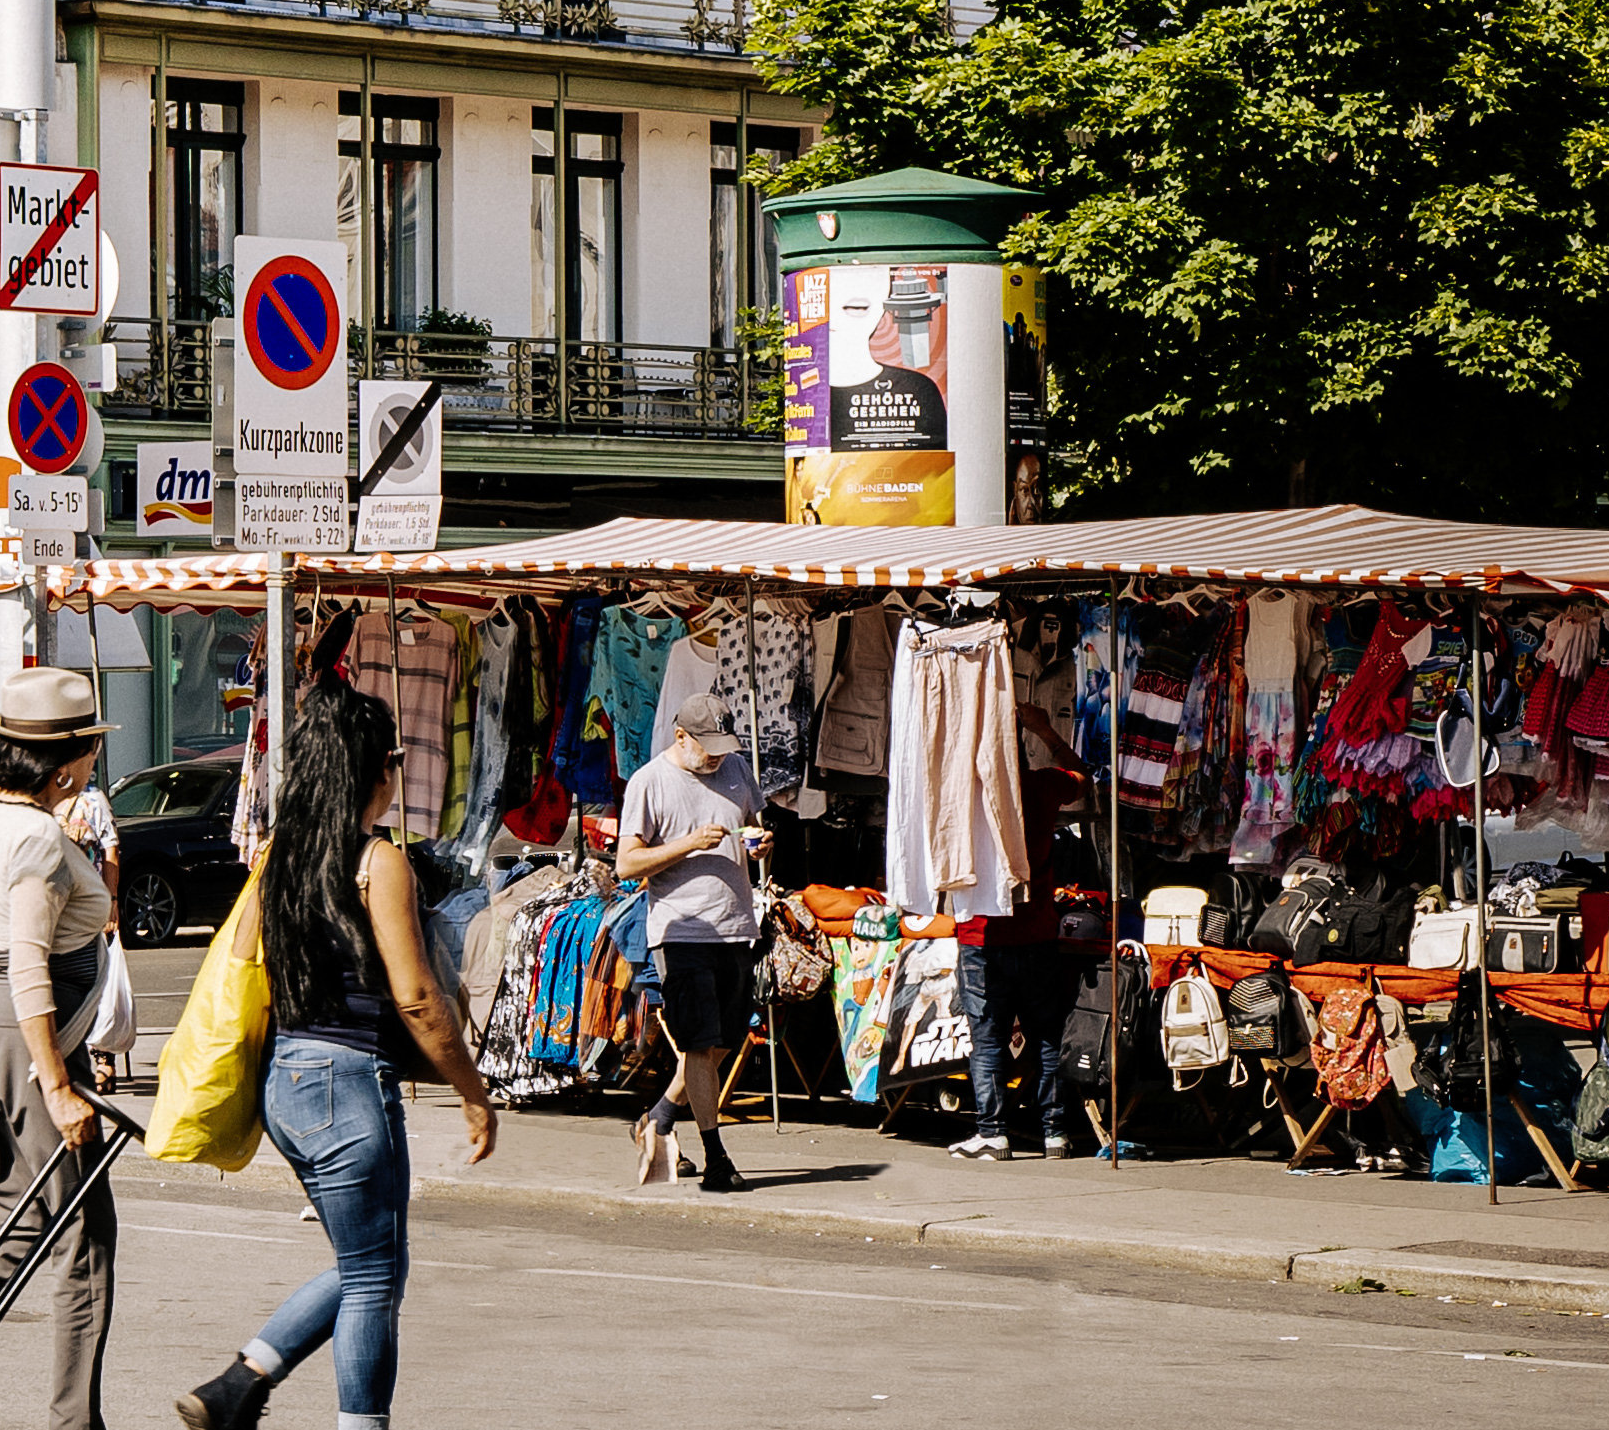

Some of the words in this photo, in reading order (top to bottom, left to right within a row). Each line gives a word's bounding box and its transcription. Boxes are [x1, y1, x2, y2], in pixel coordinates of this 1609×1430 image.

[8, 185, 90, 229] Markt-
[8, 246, 90, 294] gebiet
[850, 391, 918, 406] GEHÖRT,
[848, 405, 921, 418] GESEHEN
[240, 419, 344, 459] Kurzparkzone
[156, 457, 211, 502] dm
[14, 489, 35, 512] Sa.
[39, 499, 48, 512] v.
[241, 480, 344, 504] gebührenpflichtig
[242, 504, 308, 523] Parkdauer:
[313, 505, 319, 523] 2
[322, 505, 343, 523] Std.
[34, 539, 64, 557] Ende
